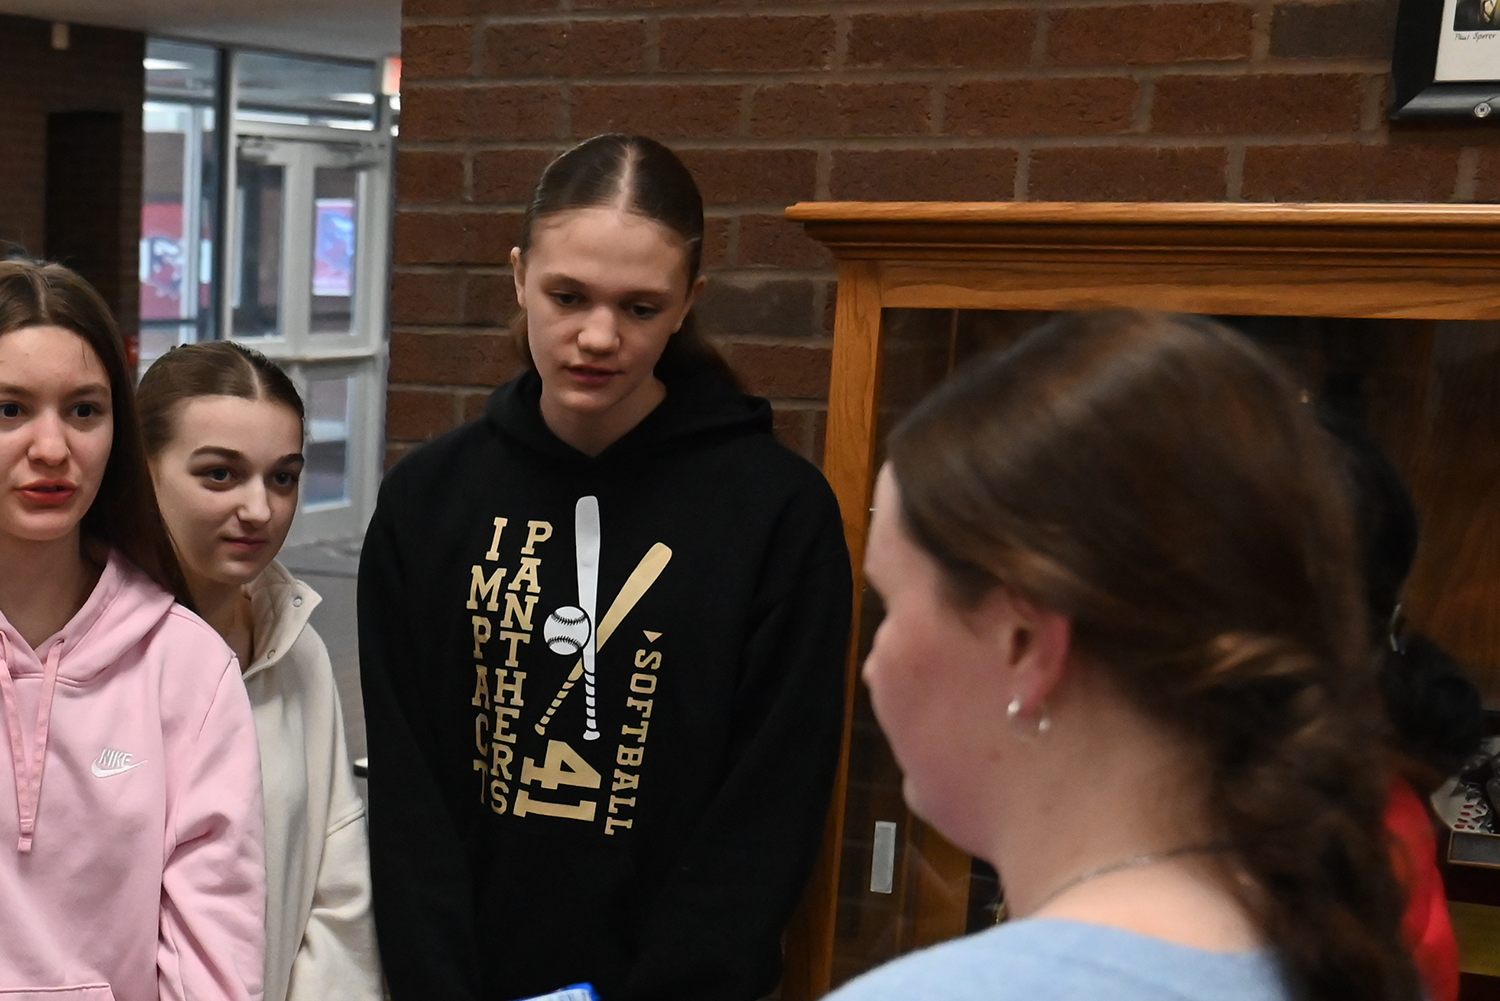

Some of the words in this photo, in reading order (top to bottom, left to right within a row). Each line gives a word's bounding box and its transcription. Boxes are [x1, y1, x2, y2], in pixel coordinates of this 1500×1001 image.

[489, 519, 554, 815] PANTHERS
[99, 748, 133, 767] NIKE
[513, 739, 603, 822] 41
[604, 648, 663, 836] SOFTBALL
